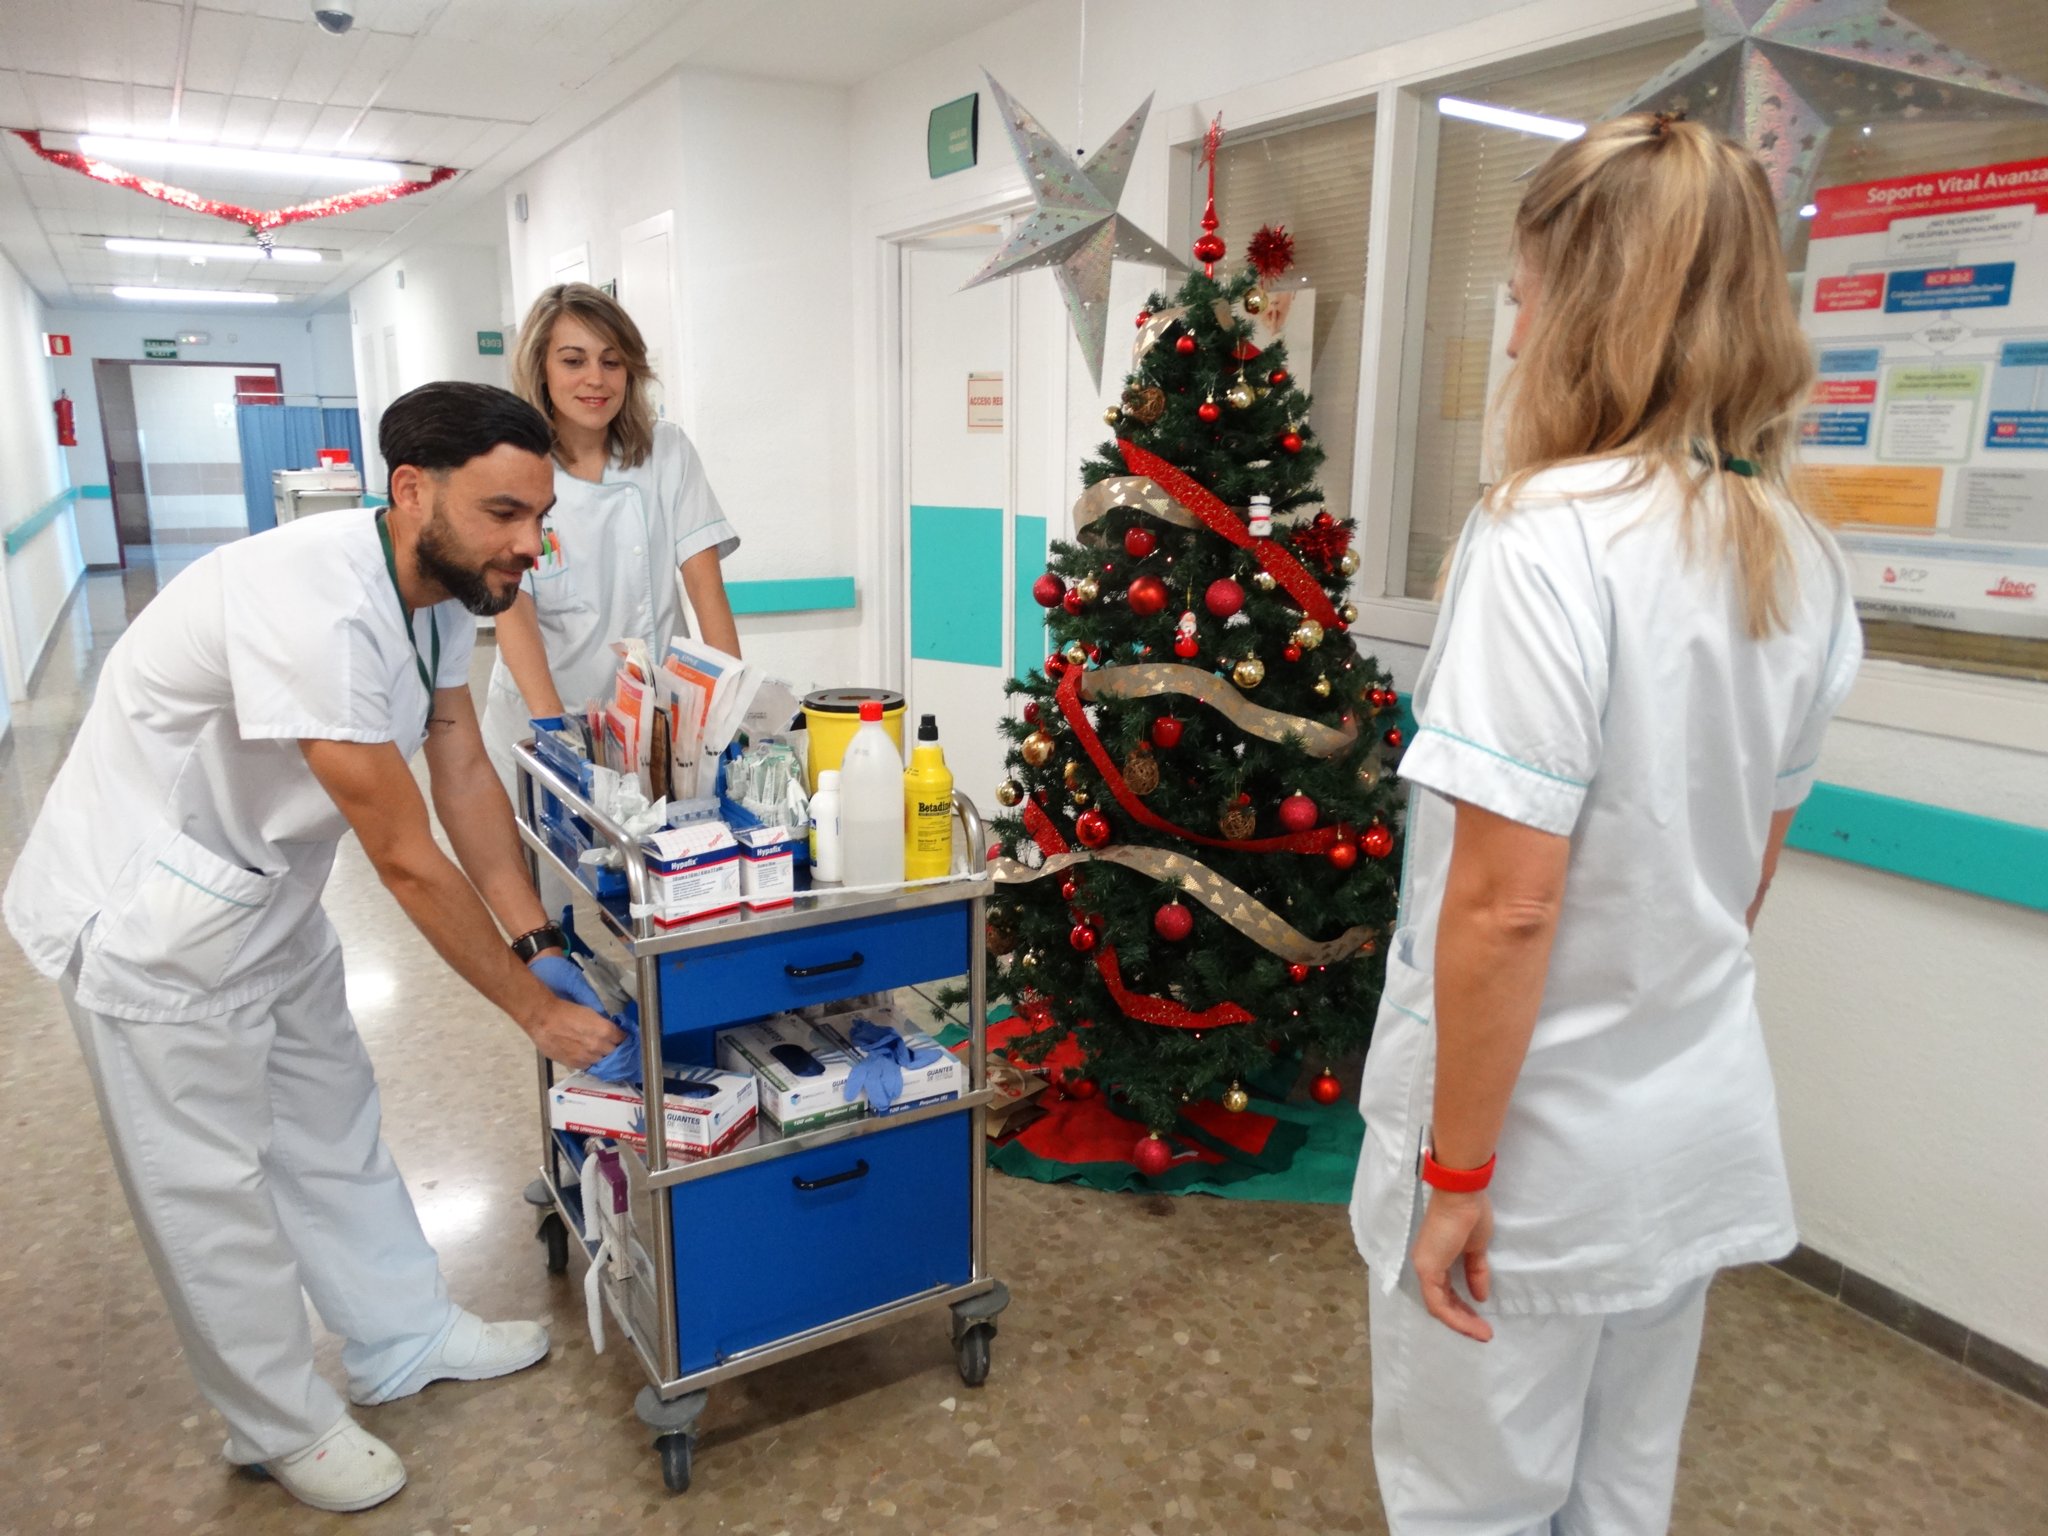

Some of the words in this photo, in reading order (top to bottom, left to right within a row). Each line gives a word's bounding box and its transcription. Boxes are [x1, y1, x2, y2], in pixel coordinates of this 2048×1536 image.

[1866, 182, 1934, 205] Soporte
[1938, 173, 1981, 194] Vital
[1856, 601, 1898, 612] EDICINA
[757, 844, 783, 857] Hypafix
[671, 856, 699, 871] Hypafix
[927, 1065, 953, 1077] GUANTES
[666, 1113, 701, 1126] GUANTES
